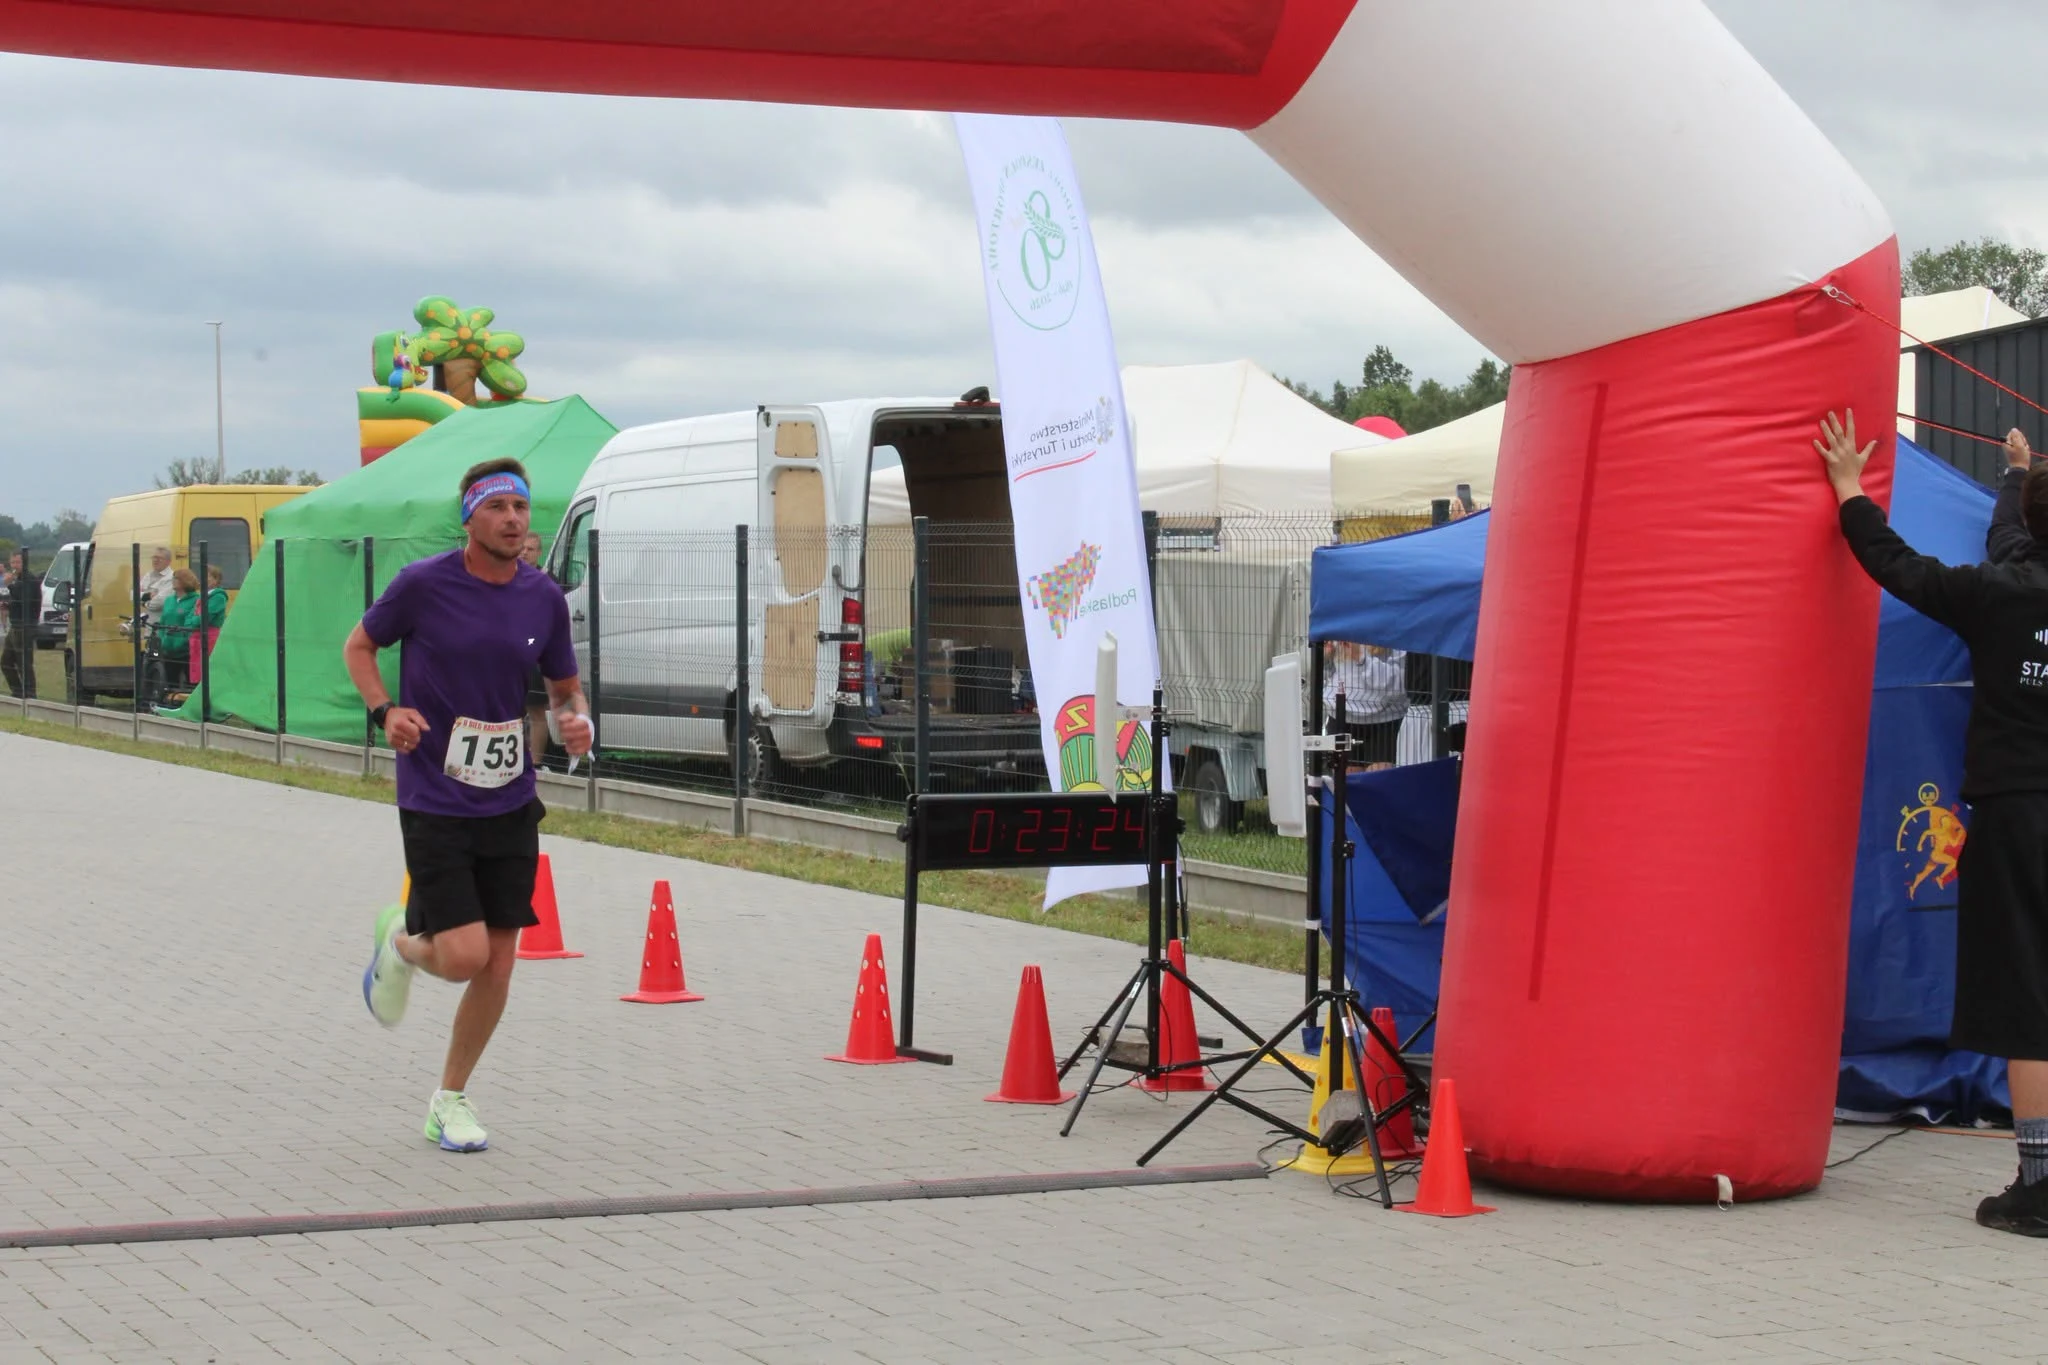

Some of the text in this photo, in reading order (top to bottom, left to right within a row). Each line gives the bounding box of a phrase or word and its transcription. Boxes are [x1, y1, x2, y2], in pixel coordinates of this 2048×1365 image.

[2020, 677, 2043, 687] PULS
[461, 734, 519, 770] 153
[969, 809, 1145, 853] 0:23:24
